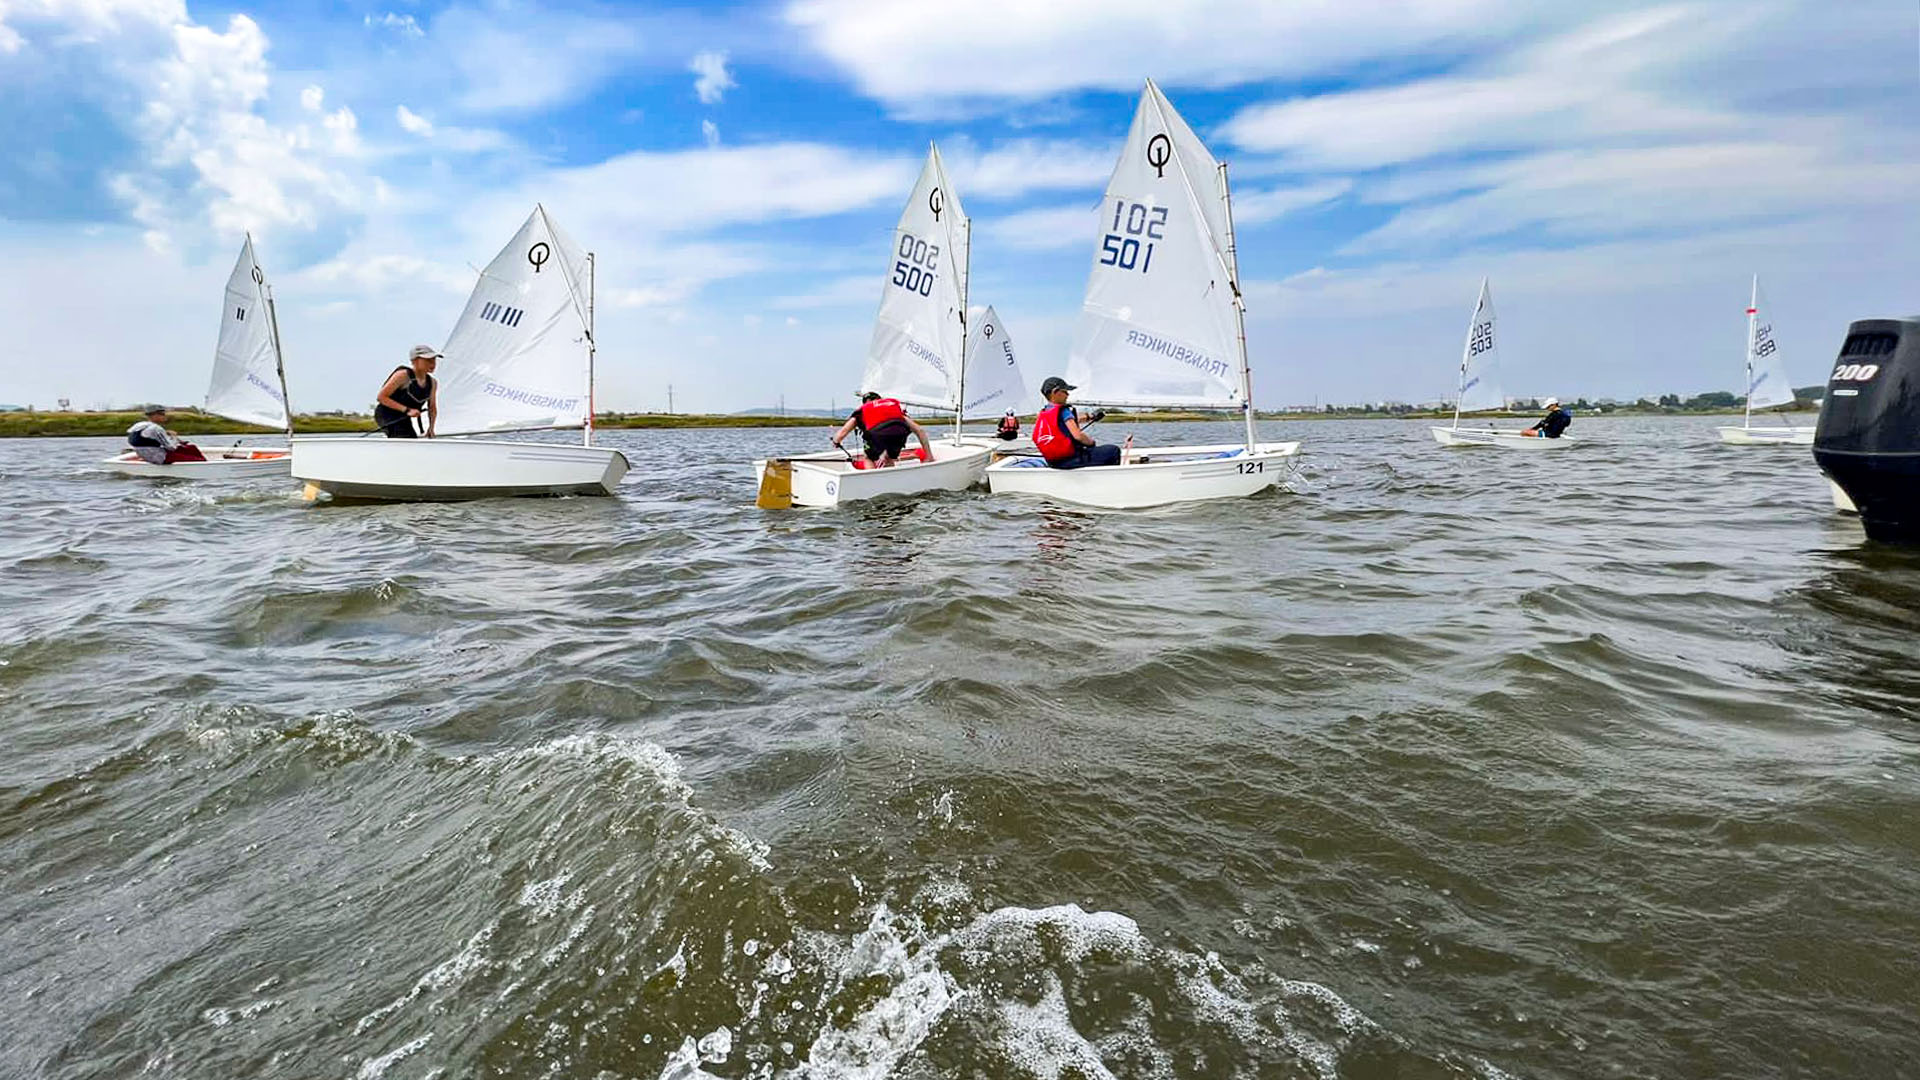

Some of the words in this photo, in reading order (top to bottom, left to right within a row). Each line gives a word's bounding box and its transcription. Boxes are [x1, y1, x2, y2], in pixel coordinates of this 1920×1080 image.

[1100, 234, 1153, 273] 501
[893, 261, 934, 297] 500
[1471, 336, 1492, 356] 503
[1832, 364, 1879, 381] 200
[1236, 462, 1264, 474] 121
